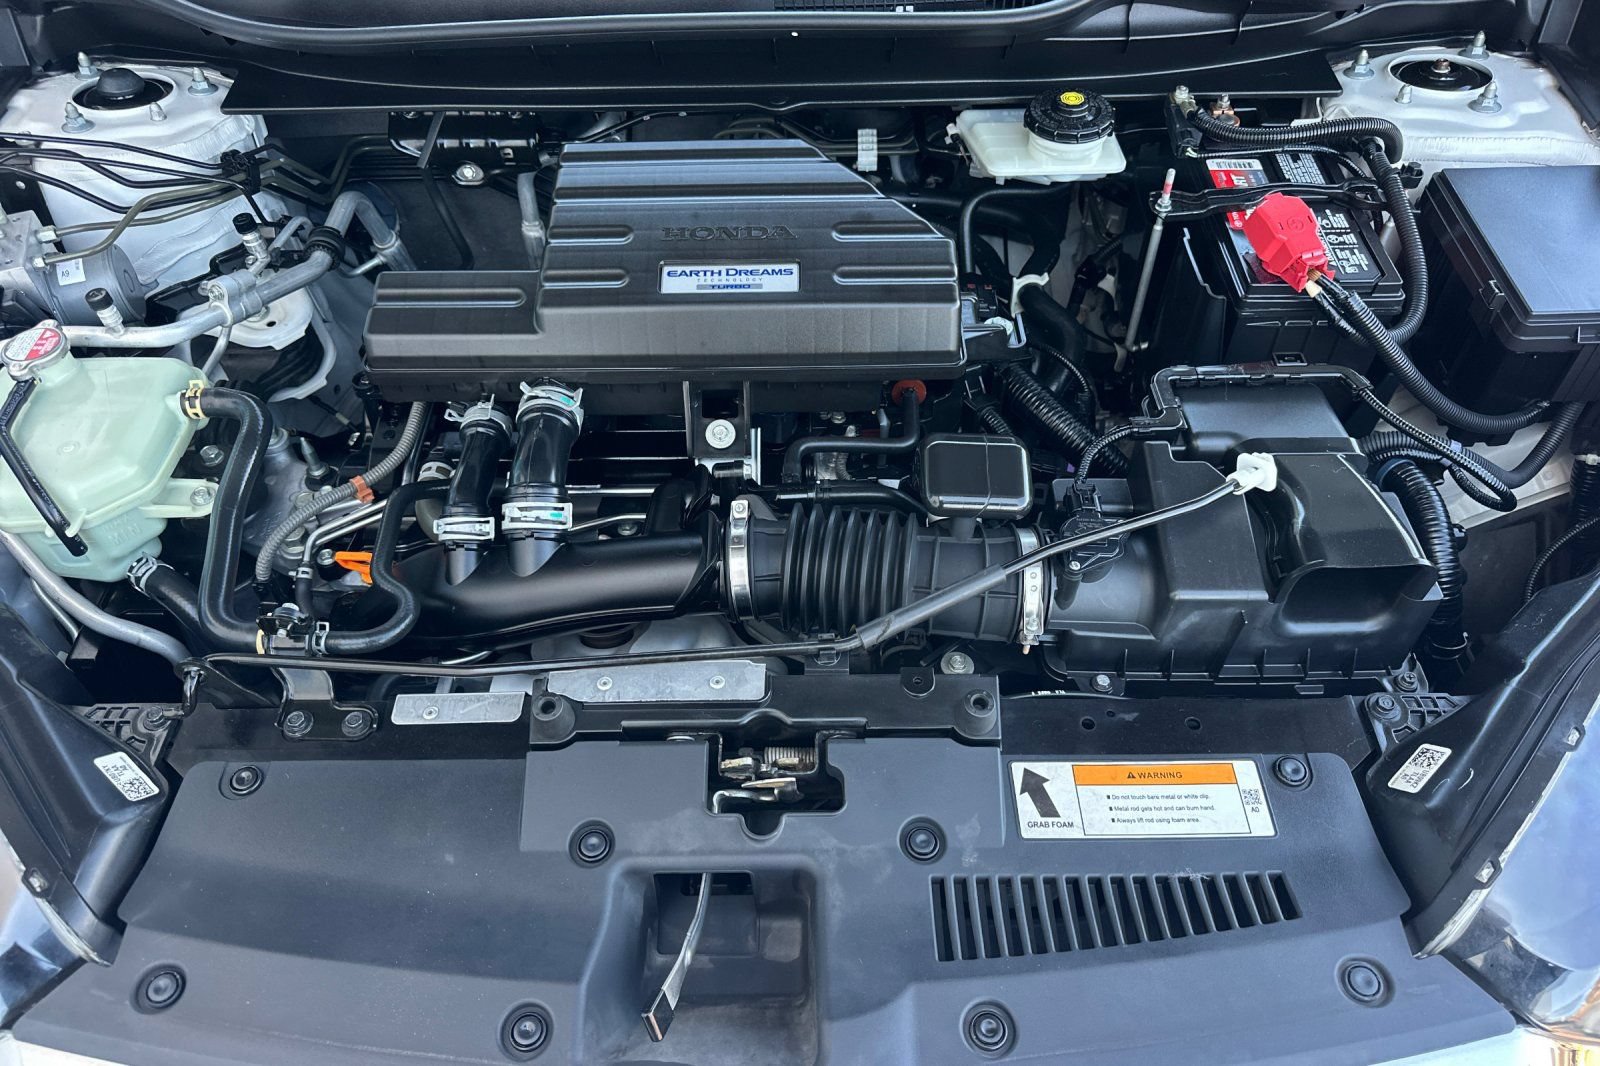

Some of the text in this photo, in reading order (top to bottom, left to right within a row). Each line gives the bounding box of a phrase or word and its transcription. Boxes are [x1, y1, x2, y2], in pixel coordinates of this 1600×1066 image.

[661, 225, 799, 241] HONDA
[666, 268, 794, 278] EARTH DREAMS
[1137, 771, 1183, 779] WARNING
[1051, 821, 1075, 829] FOAM
[1116, 817, 1136, 825] Always
